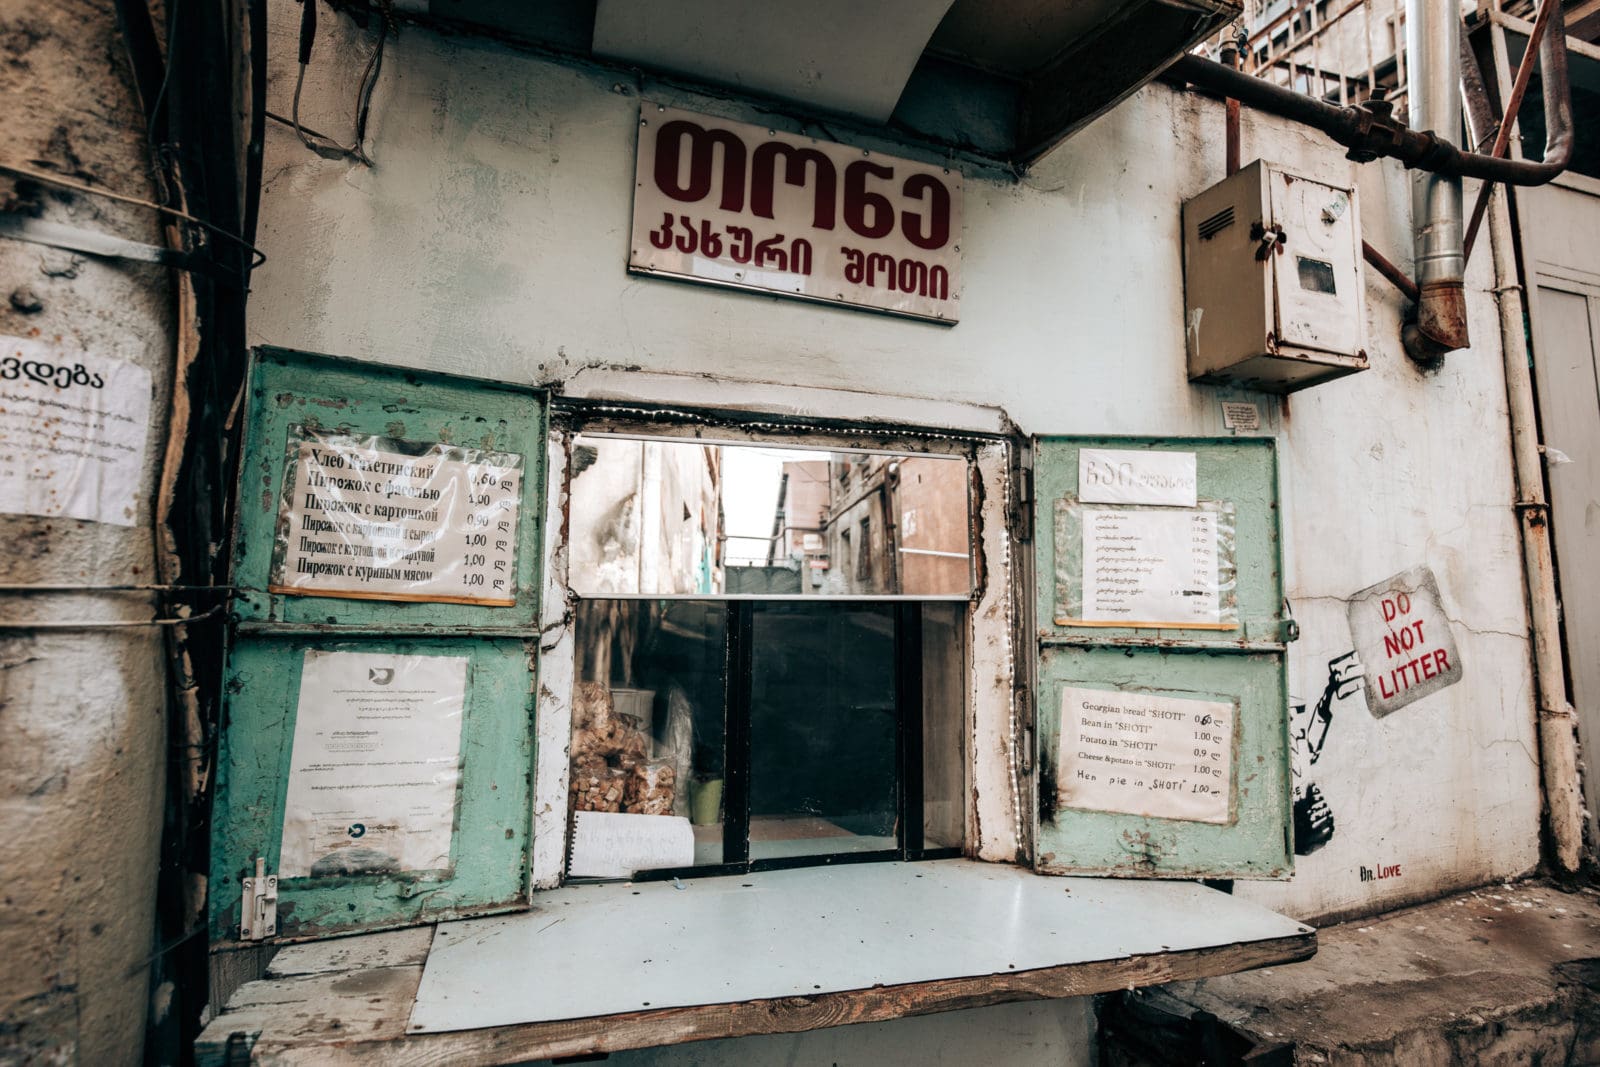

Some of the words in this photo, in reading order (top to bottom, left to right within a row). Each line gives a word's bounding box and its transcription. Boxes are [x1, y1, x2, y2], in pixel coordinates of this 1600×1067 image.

[654, 120, 950, 249] თონე
[650, 212, 812, 276] კახური
[841, 246, 948, 301] შოთი
[0, 357, 104, 389] ვდება
[312, 448, 344, 469] Хлеб
[307, 470, 371, 493] Пирожок
[374, 482, 381, 493] с
[304, 494, 362, 514] Пирожок
[365, 503, 371, 514] с
[374, 504, 438, 521] картошкой
[302, 515, 343, 535] Пирожок
[466, 534, 487, 547] 1,00
[299, 536, 337, 556] Пирожок
[464, 554, 485, 567] 1,00
[297, 557, 345, 578] Пирожок
[348, 564, 353, 576] с
[355, 565, 401, 582] куриным
[403, 568, 433, 581] мясом
[463, 573, 484, 586] 1,00
[1382, 591, 1411, 622] DO
[1384, 619, 1425, 659] NOT
[1378, 648, 1452, 699] LITTER
[1081, 717, 1102, 728] Bean
[1104, 719, 1112, 729] in
[1082, 702, 1121, 714] Georgian
[1123, 706, 1146, 717] bread
[1080, 734, 1107, 745] Potato
[1109, 736, 1118, 747] in
[1078, 751, 1102, 762] Cheese
[1135, 759, 1143, 767] in
[1077, 769, 1097, 781] Hen
[1109, 775, 1127, 785] pie
[1134, 778, 1143, 787] in
[1377, 863, 1402, 880] LOVE
